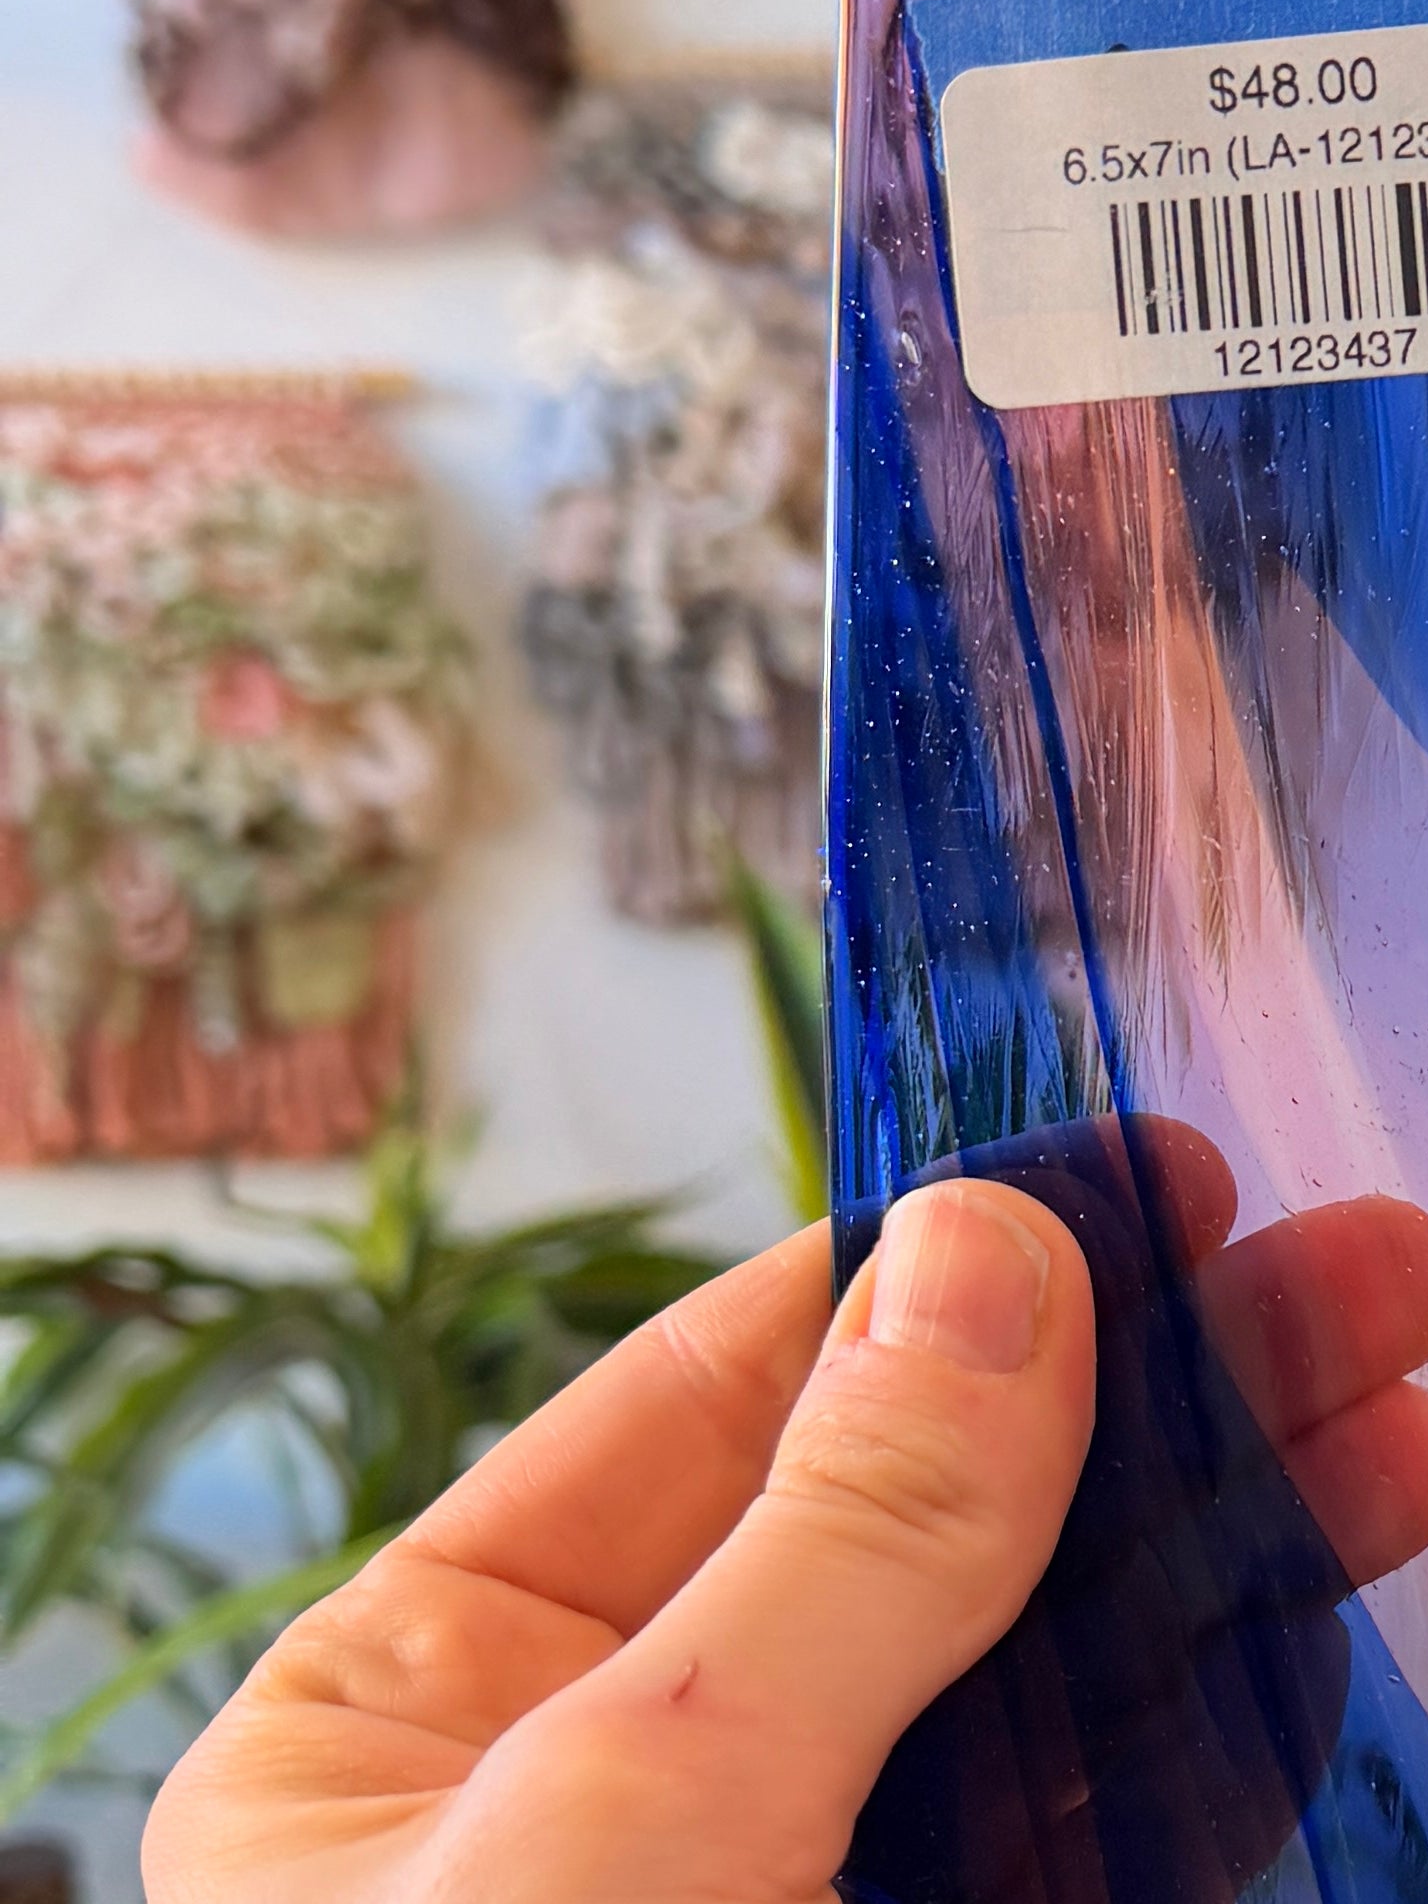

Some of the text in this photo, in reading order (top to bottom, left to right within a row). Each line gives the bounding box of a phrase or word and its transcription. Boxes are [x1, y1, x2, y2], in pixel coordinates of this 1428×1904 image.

[1208, 56, 1379, 116] $48.00
[1062, 140, 1210, 185] 6.5x7in
[1213, 327, 1418, 377] 12123437
